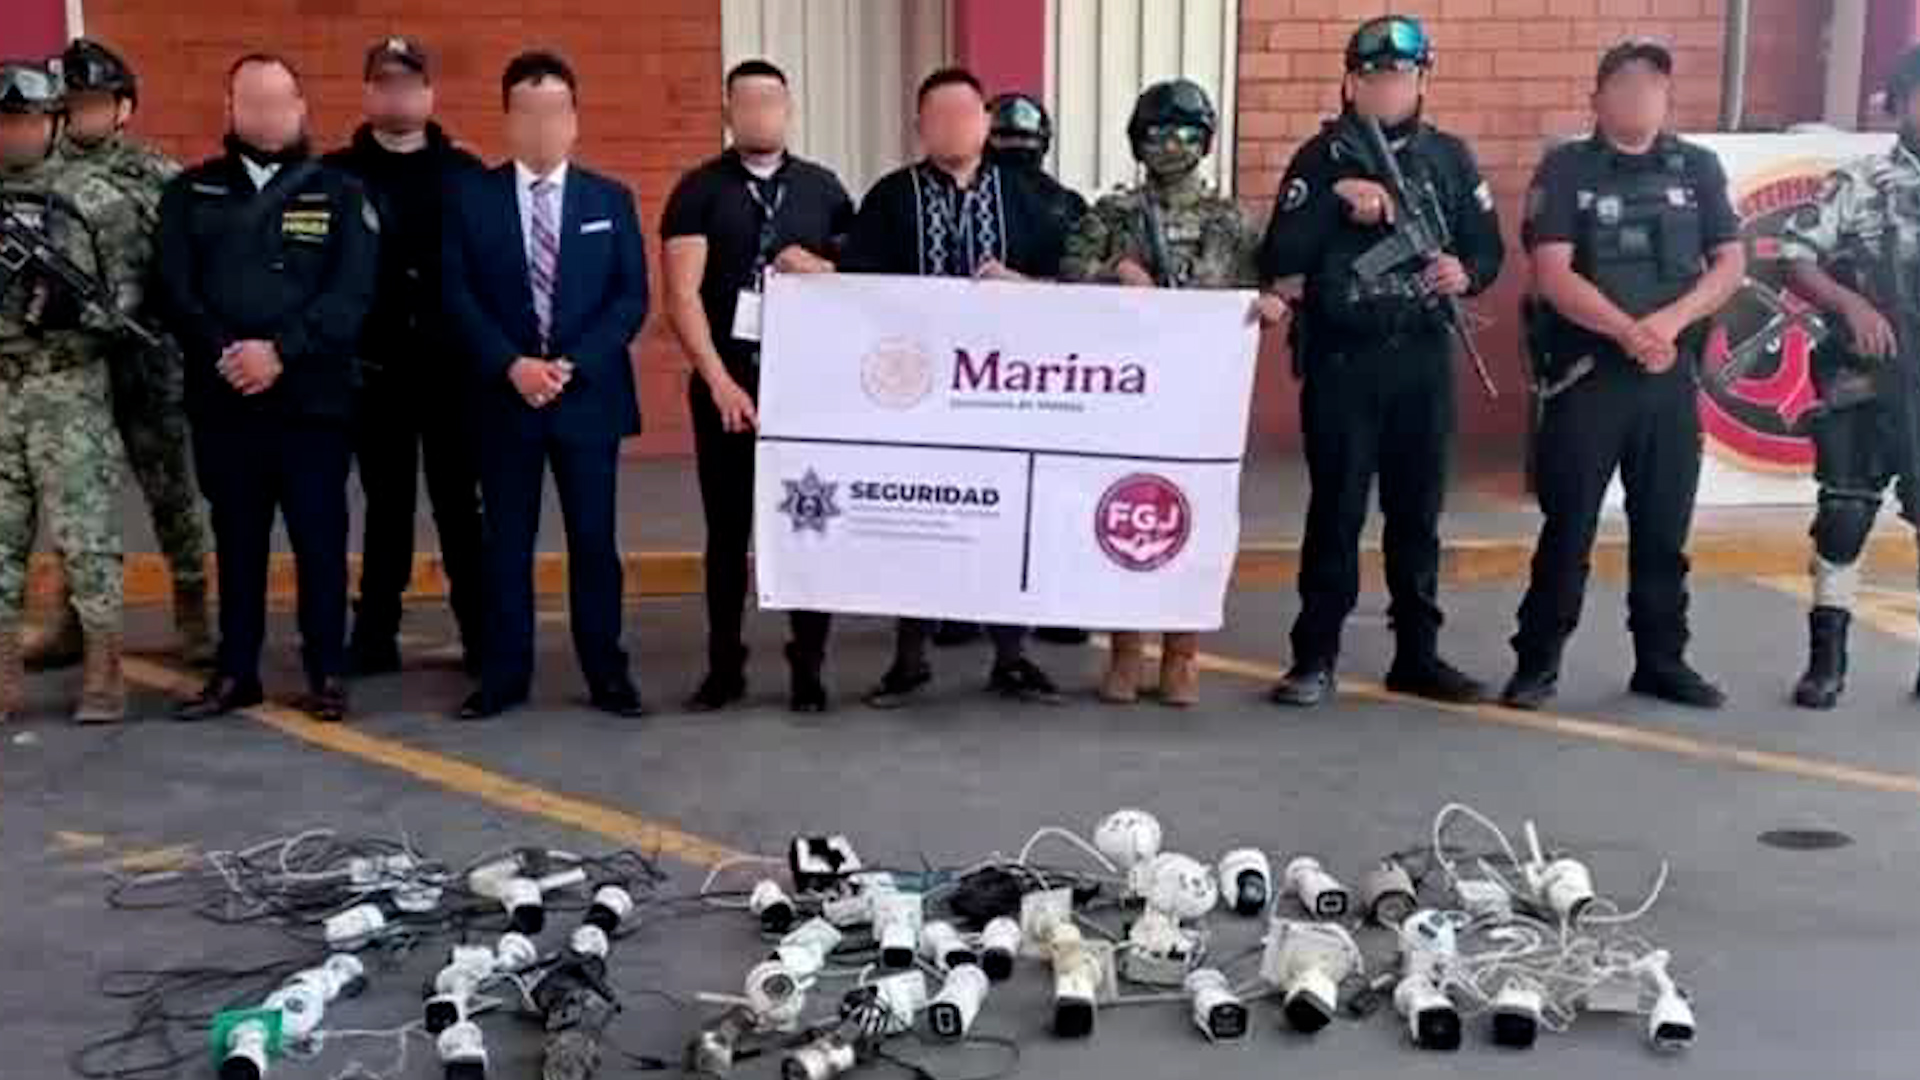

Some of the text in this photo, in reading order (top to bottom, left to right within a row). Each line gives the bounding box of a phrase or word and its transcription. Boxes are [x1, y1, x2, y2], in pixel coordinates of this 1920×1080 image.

[951, 347, 1147, 395] Marina
[850, 480, 1000, 506] SEGURIDAD
[1107, 502, 1179, 531] FGJ
